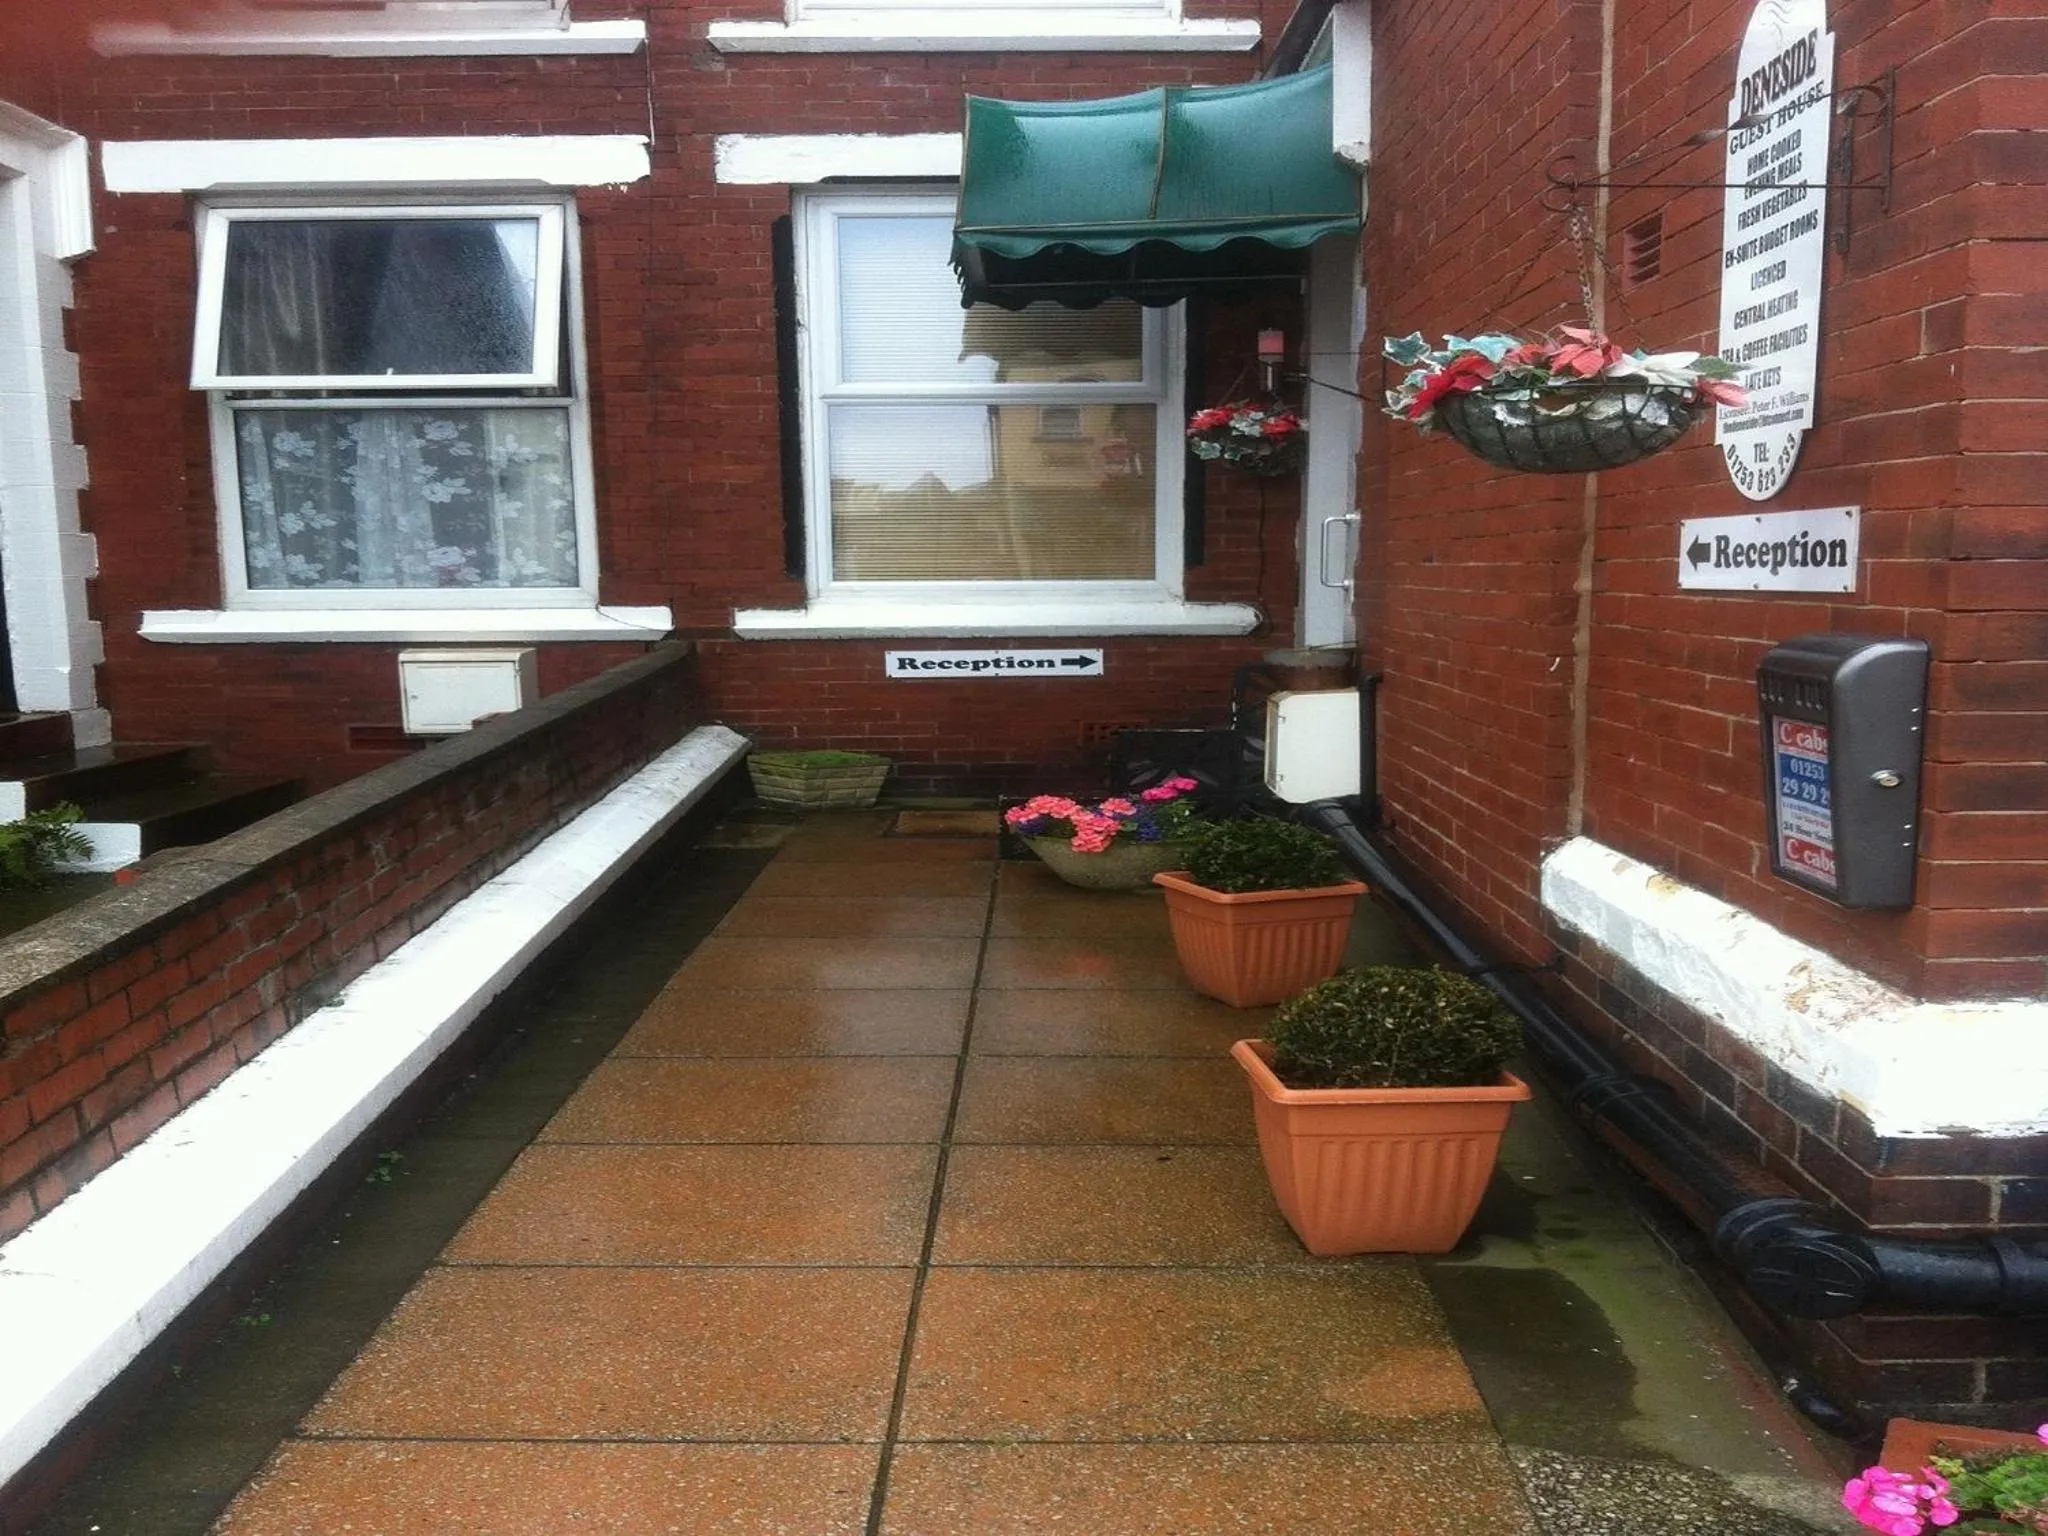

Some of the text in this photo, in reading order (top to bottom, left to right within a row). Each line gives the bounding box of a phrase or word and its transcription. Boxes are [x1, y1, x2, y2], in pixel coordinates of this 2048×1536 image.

[1741, 27, 1817, 117] DENESIDE
[1730, 80, 1824, 155] GUEST HOUSE
[1747, 129, 1801, 177] HOME COOKED
[1744, 151, 1802, 200] EVENING MEALS
[1738, 179, 1807, 232] FRESH VEGETABLES
[1759, 223, 1788, 254] BUDGET
[1789, 208, 1818, 241] ROOMS
[1734, 289, 1798, 330] CENTRAL HEATING
[1722, 347, 1734, 362] TEA
[1742, 337, 1768, 361] COFFEE
[1769, 323, 1808, 354] FACILITIES
[1763, 366, 1781, 388] KEYS
[1727, 444, 1754, 491] 01253
[1713, 530, 1848, 576] Reception
[897, 656, 1056, 672] Reception
[1780, 723, 1792, 744] C
[1782, 777, 1799, 795] 29
[1802, 783, 1817, 800] 29
[1790, 758, 1825, 781] 01253
[1786, 838, 1799, 859] C
